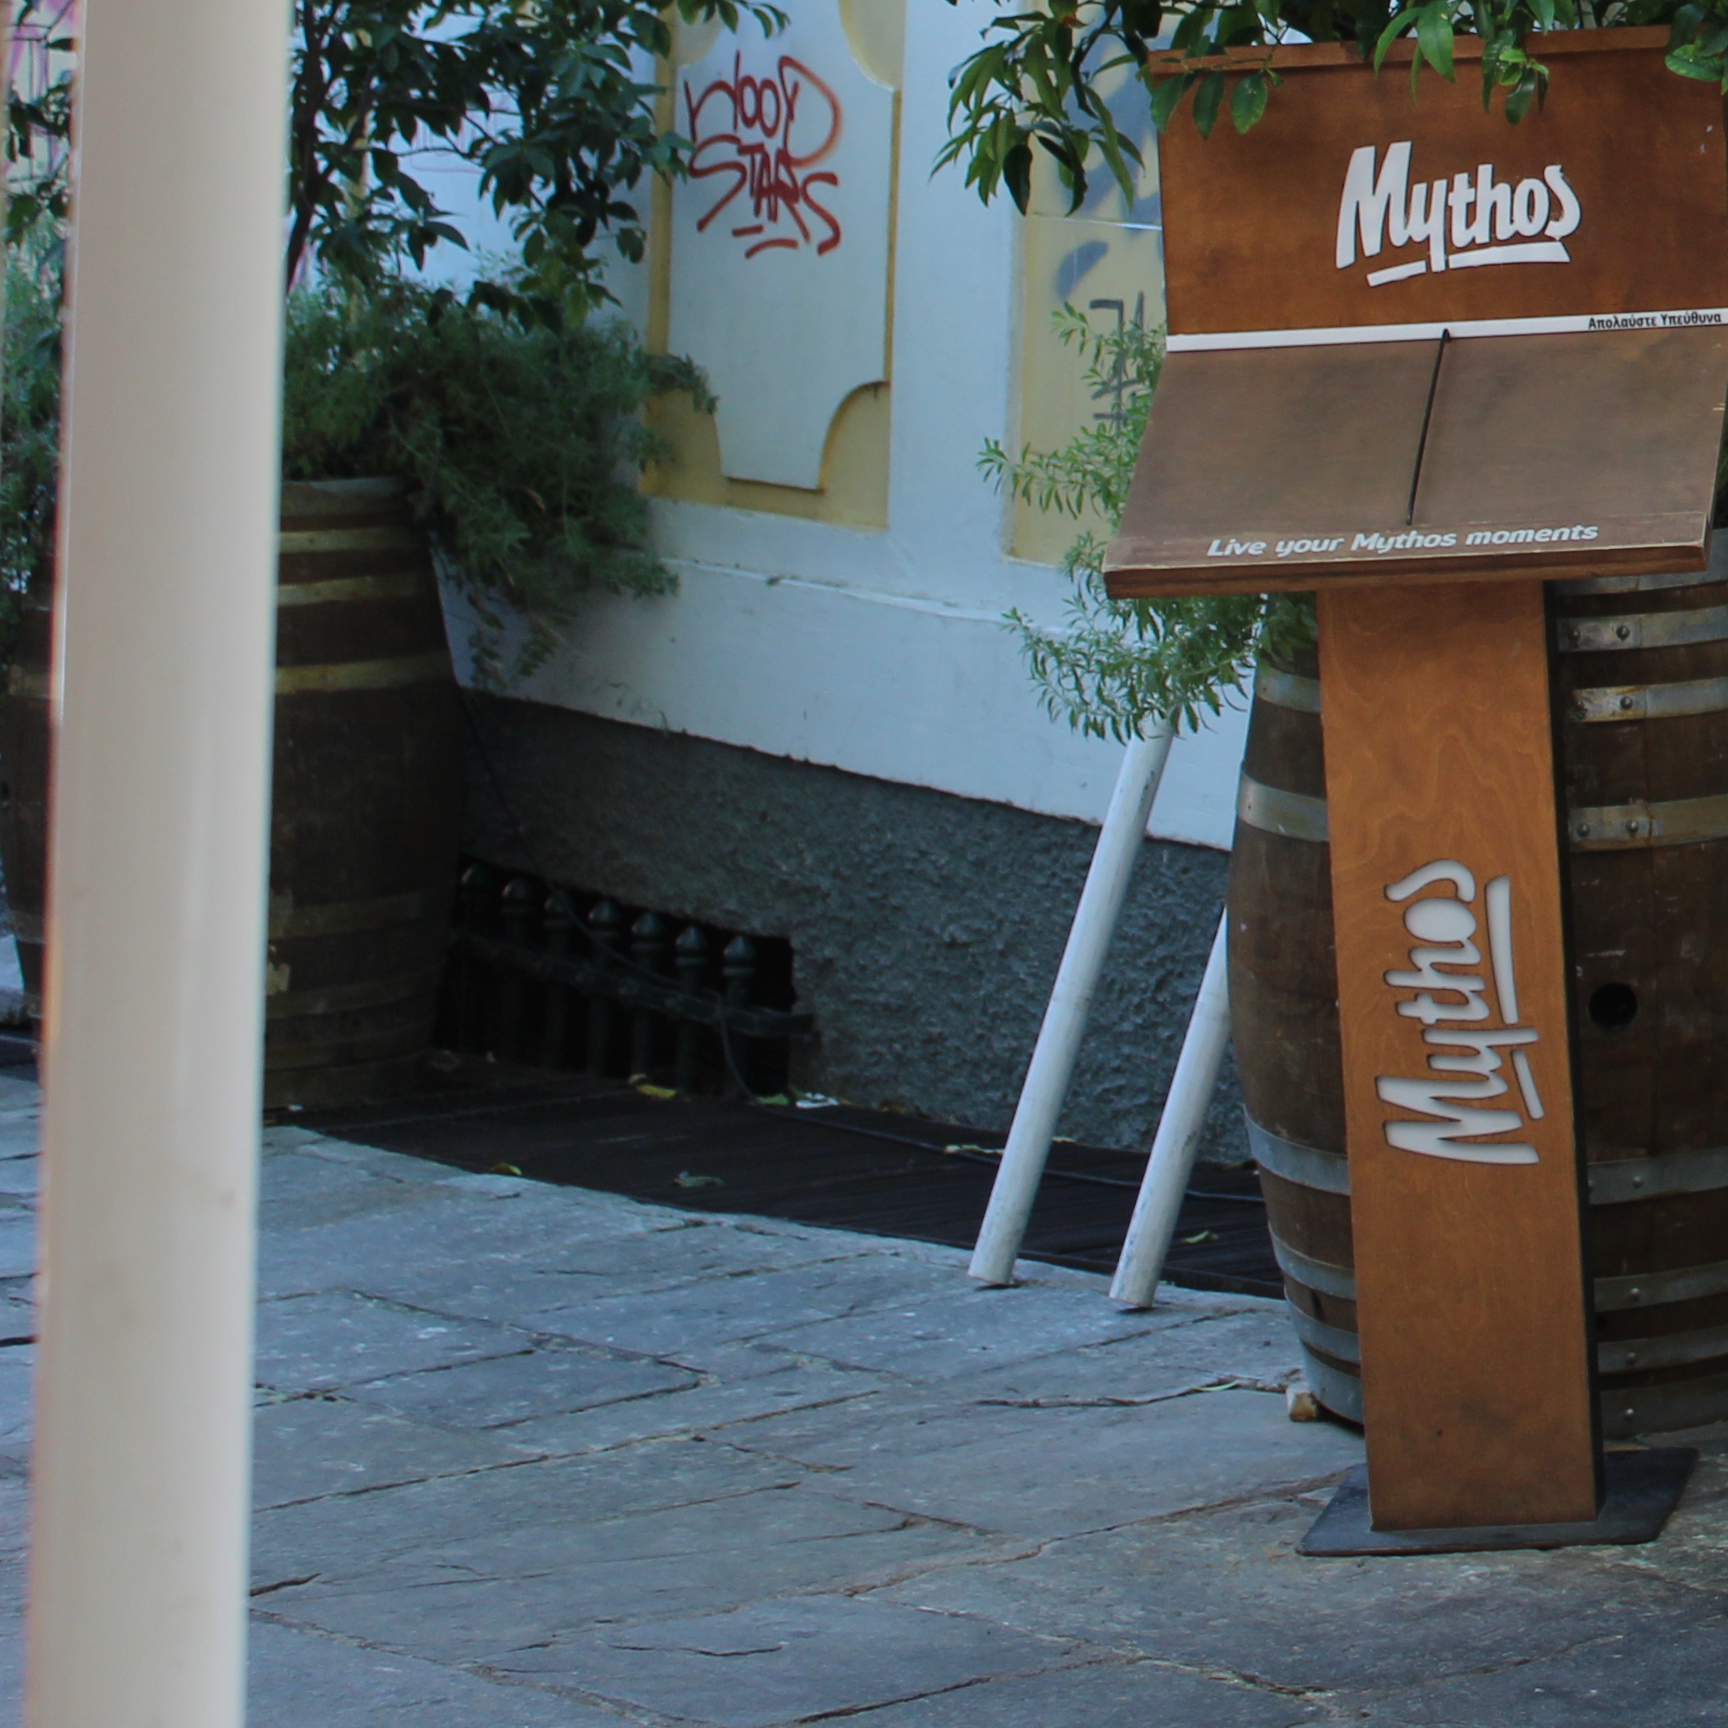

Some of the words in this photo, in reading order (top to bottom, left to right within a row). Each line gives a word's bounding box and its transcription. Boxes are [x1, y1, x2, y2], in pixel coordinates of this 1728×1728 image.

[1335, 140, 1581, 275] Mythos
[1588, 313, 1657, 331] Απολαύστε
[1660, 310, 1722, 326] Υπεύθυνα
[1206, 538, 1266, 557] Live
[1275, 536, 1344, 558] your
[1350, 530, 1457, 555] Mythos
[1465, 524, 1599, 546] moments
[1375, 859, 1541, 1165] Mythos
